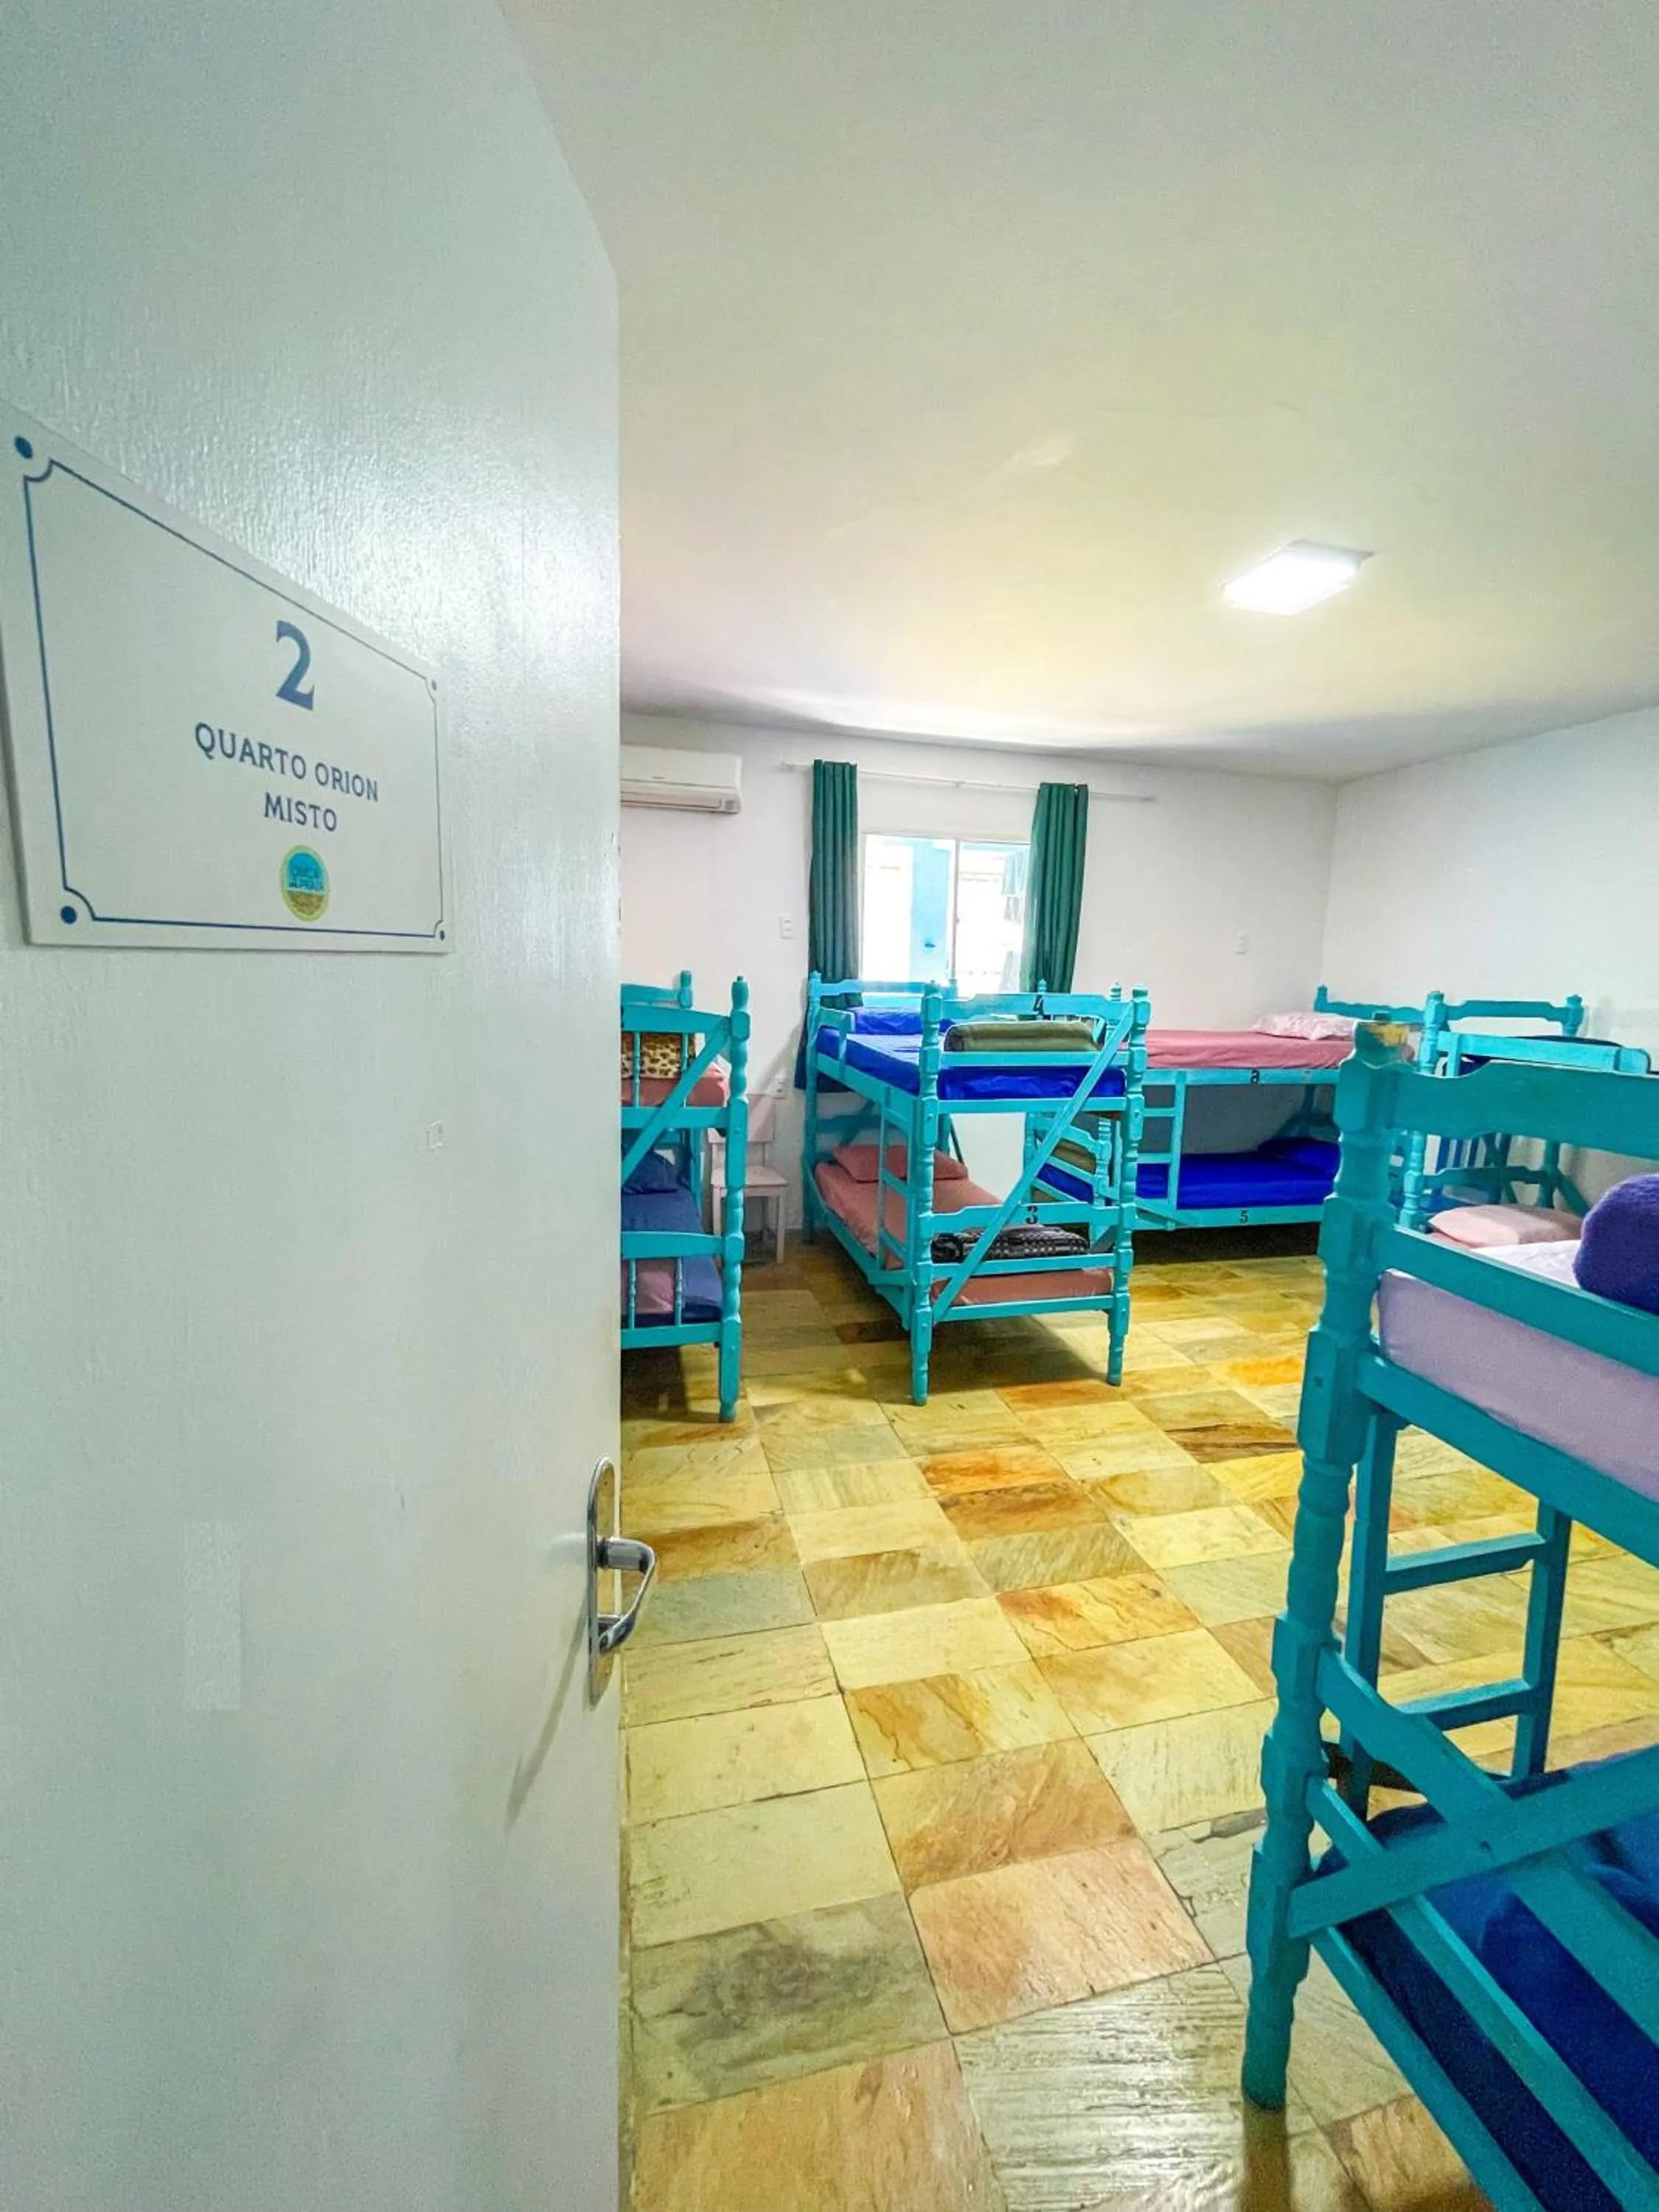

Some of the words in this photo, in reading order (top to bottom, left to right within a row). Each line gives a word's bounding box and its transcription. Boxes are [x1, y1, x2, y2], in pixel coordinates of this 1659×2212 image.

[276, 620, 315, 711] 2
[195, 722, 306, 779] QUARTO
[314, 762, 378, 802] ORION
[263, 791, 337, 832] MISTO
[1033, 994, 1045, 1015] 4
[1026, 1206, 1038, 1225] 3
[1239, 1209, 1249, 1224] 5
